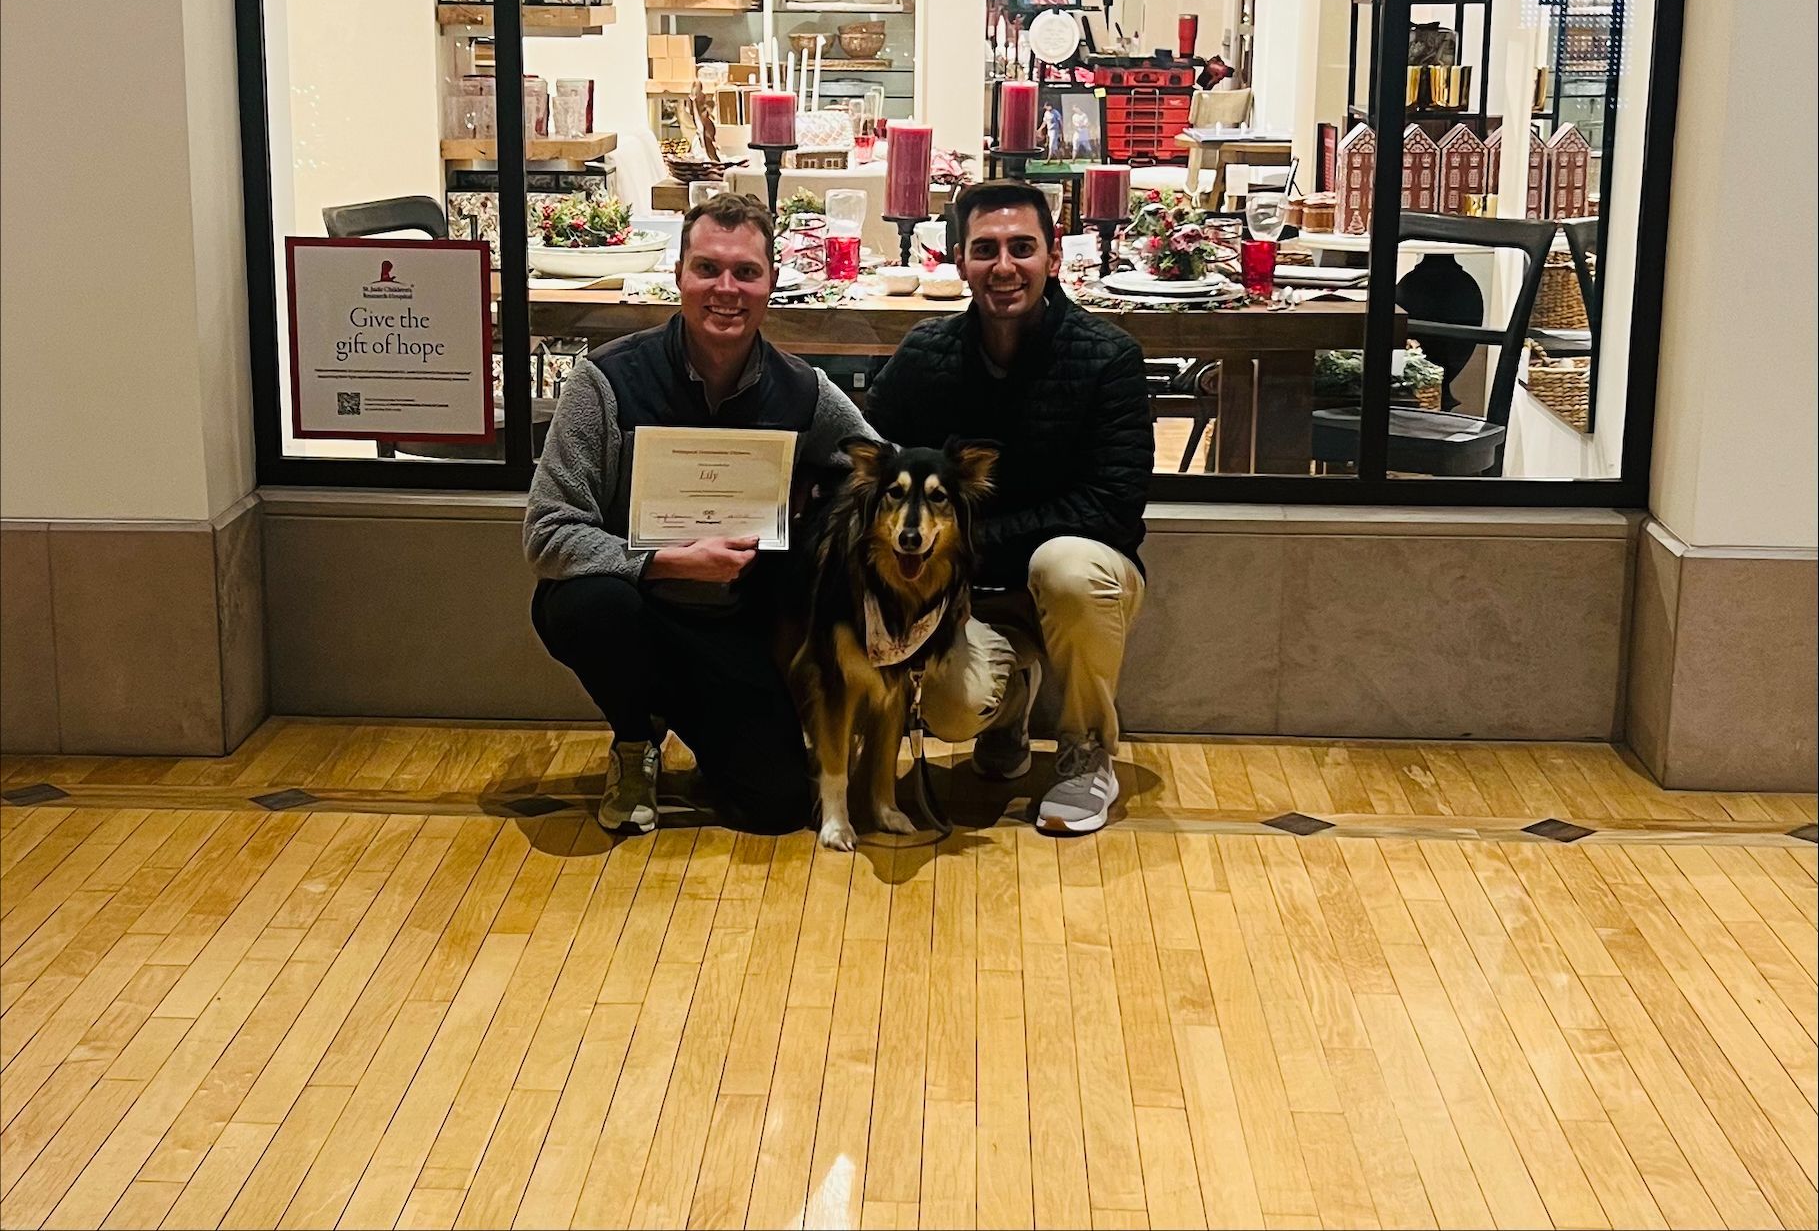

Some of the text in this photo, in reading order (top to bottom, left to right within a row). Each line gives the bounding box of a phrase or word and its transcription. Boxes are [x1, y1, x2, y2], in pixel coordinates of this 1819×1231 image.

[349, 307, 430, 329] Give the
[336, 331, 445, 363] gift of hope
[699, 469, 719, 483] Lily
